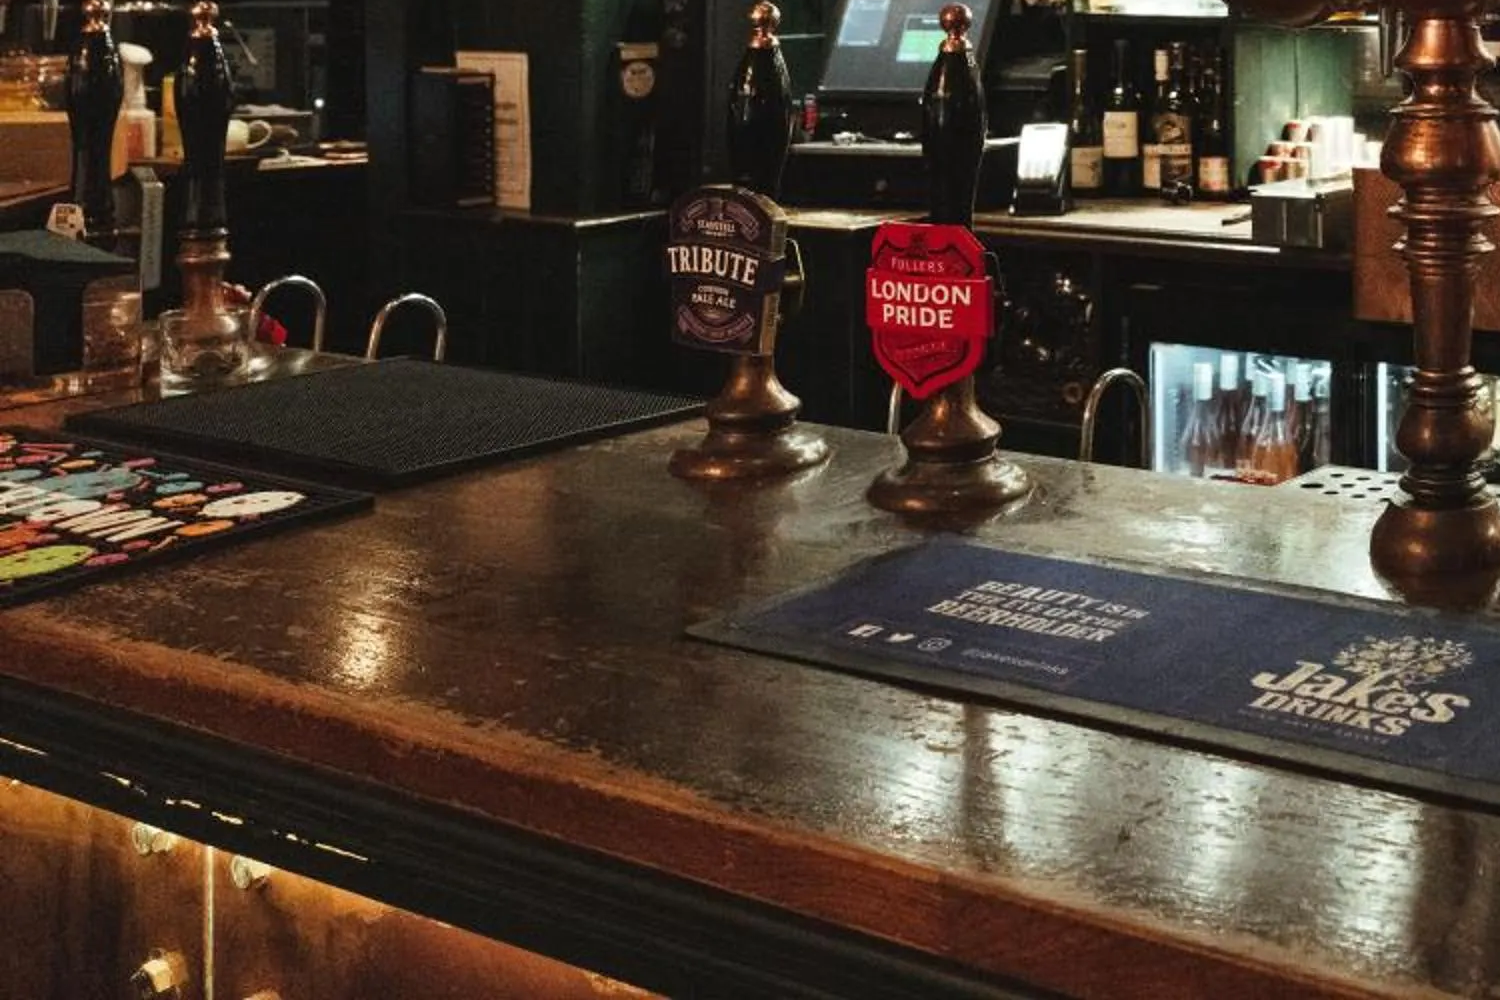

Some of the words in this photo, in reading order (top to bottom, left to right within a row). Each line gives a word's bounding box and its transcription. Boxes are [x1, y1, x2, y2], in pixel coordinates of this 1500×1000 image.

[667, 245, 760, 287] TRIBUTE
[870, 278, 972, 306] LONDON
[882, 303, 954, 329] PRIDE
[976, 580, 1102, 609] BEAUTY
[925, 599, 1116, 643] BEERHOLDER
[1043, 606, 1087, 620] OF
[1249, 691, 1412, 737] DRINKS
